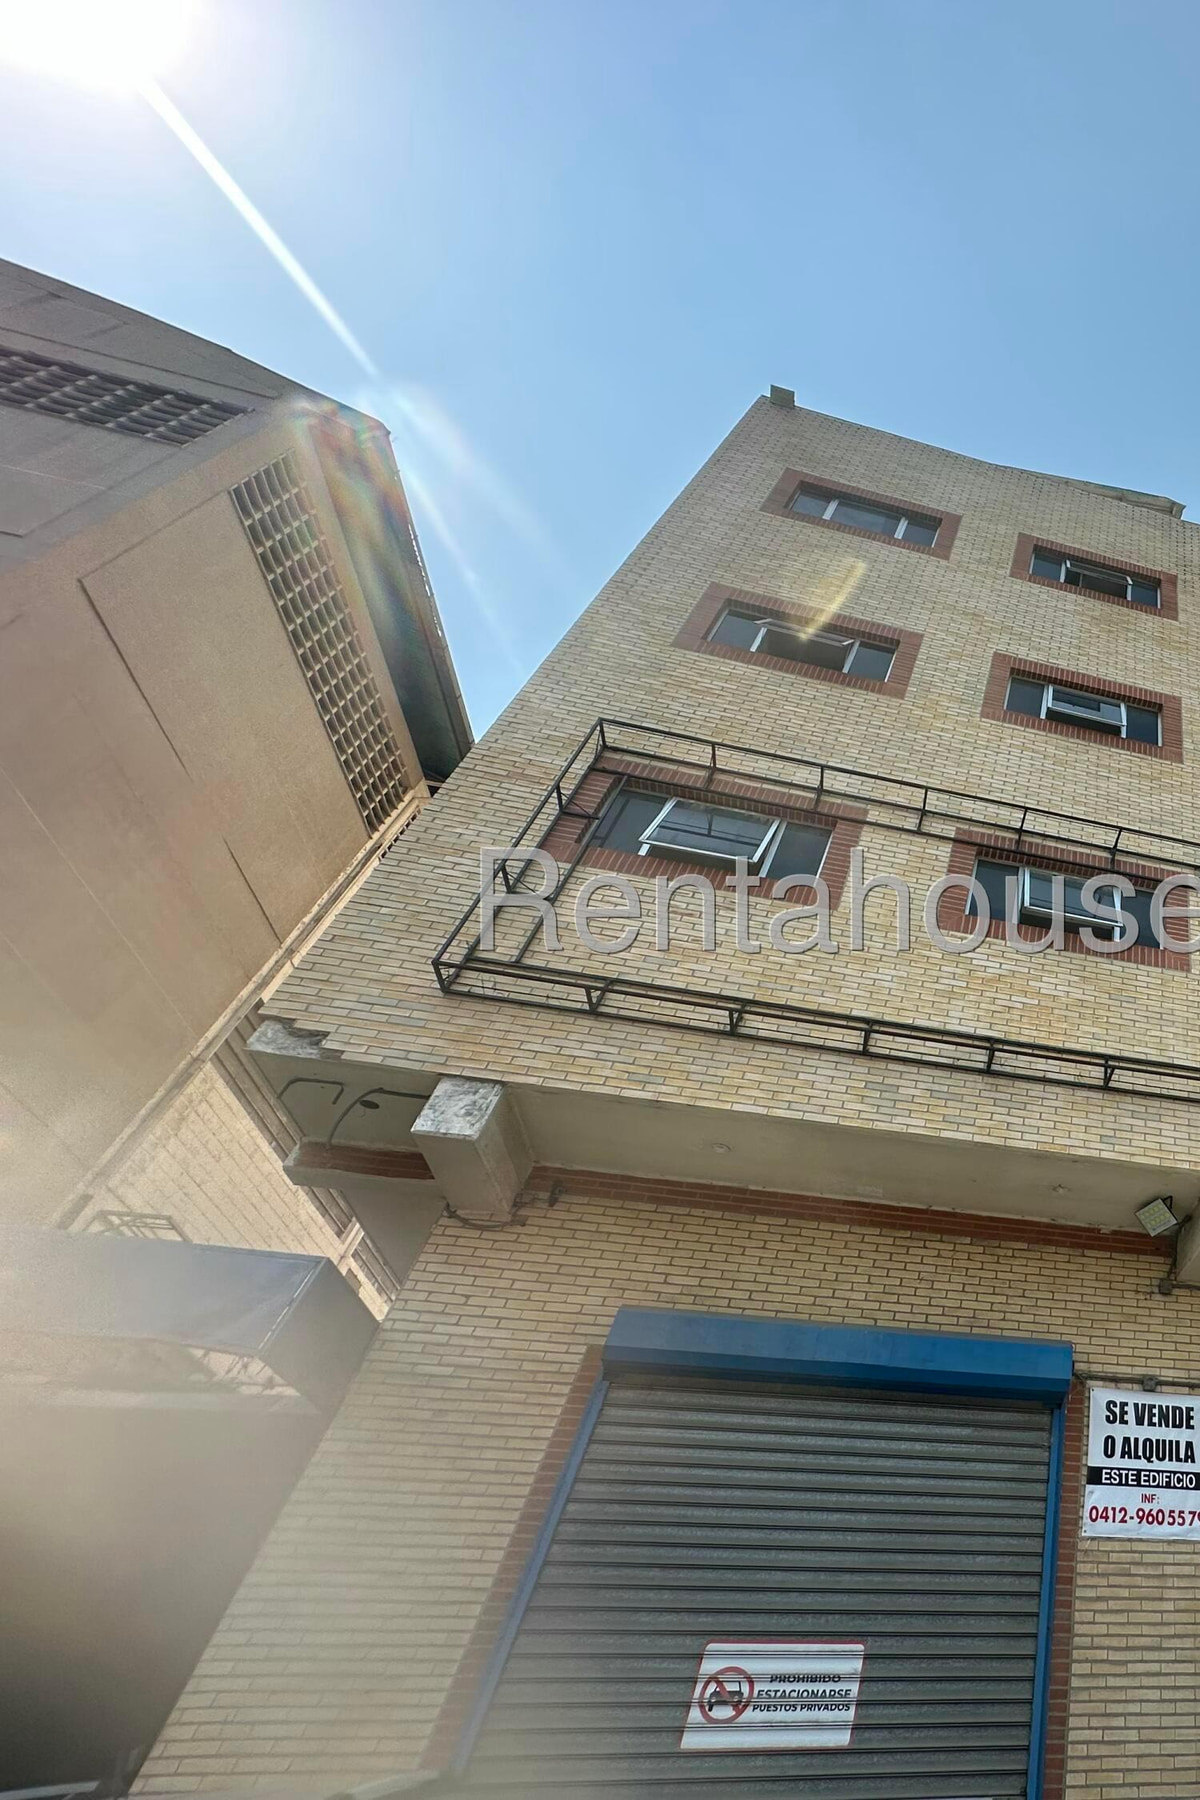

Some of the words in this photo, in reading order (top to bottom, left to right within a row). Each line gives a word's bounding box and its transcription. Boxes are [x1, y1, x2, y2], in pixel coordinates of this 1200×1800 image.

[1105, 1400, 1129, 1425] SE
[1133, 1402, 1195, 1430] VENDE
[1103, 1435, 1116, 1459] O
[1119, 1436, 1196, 1464] ALQUILA
[1101, 1469, 1137, 1485] ESTE
[1140, 1471, 1196, 1488] EDIFICIO
[769, 1674, 842, 1683] PROHIBIDO
[756, 1689, 852, 1699] ESTACIONARSE
[752, 1704, 798, 1712] PUESTOS
[799, 1703, 851, 1712] PRIVADOS
